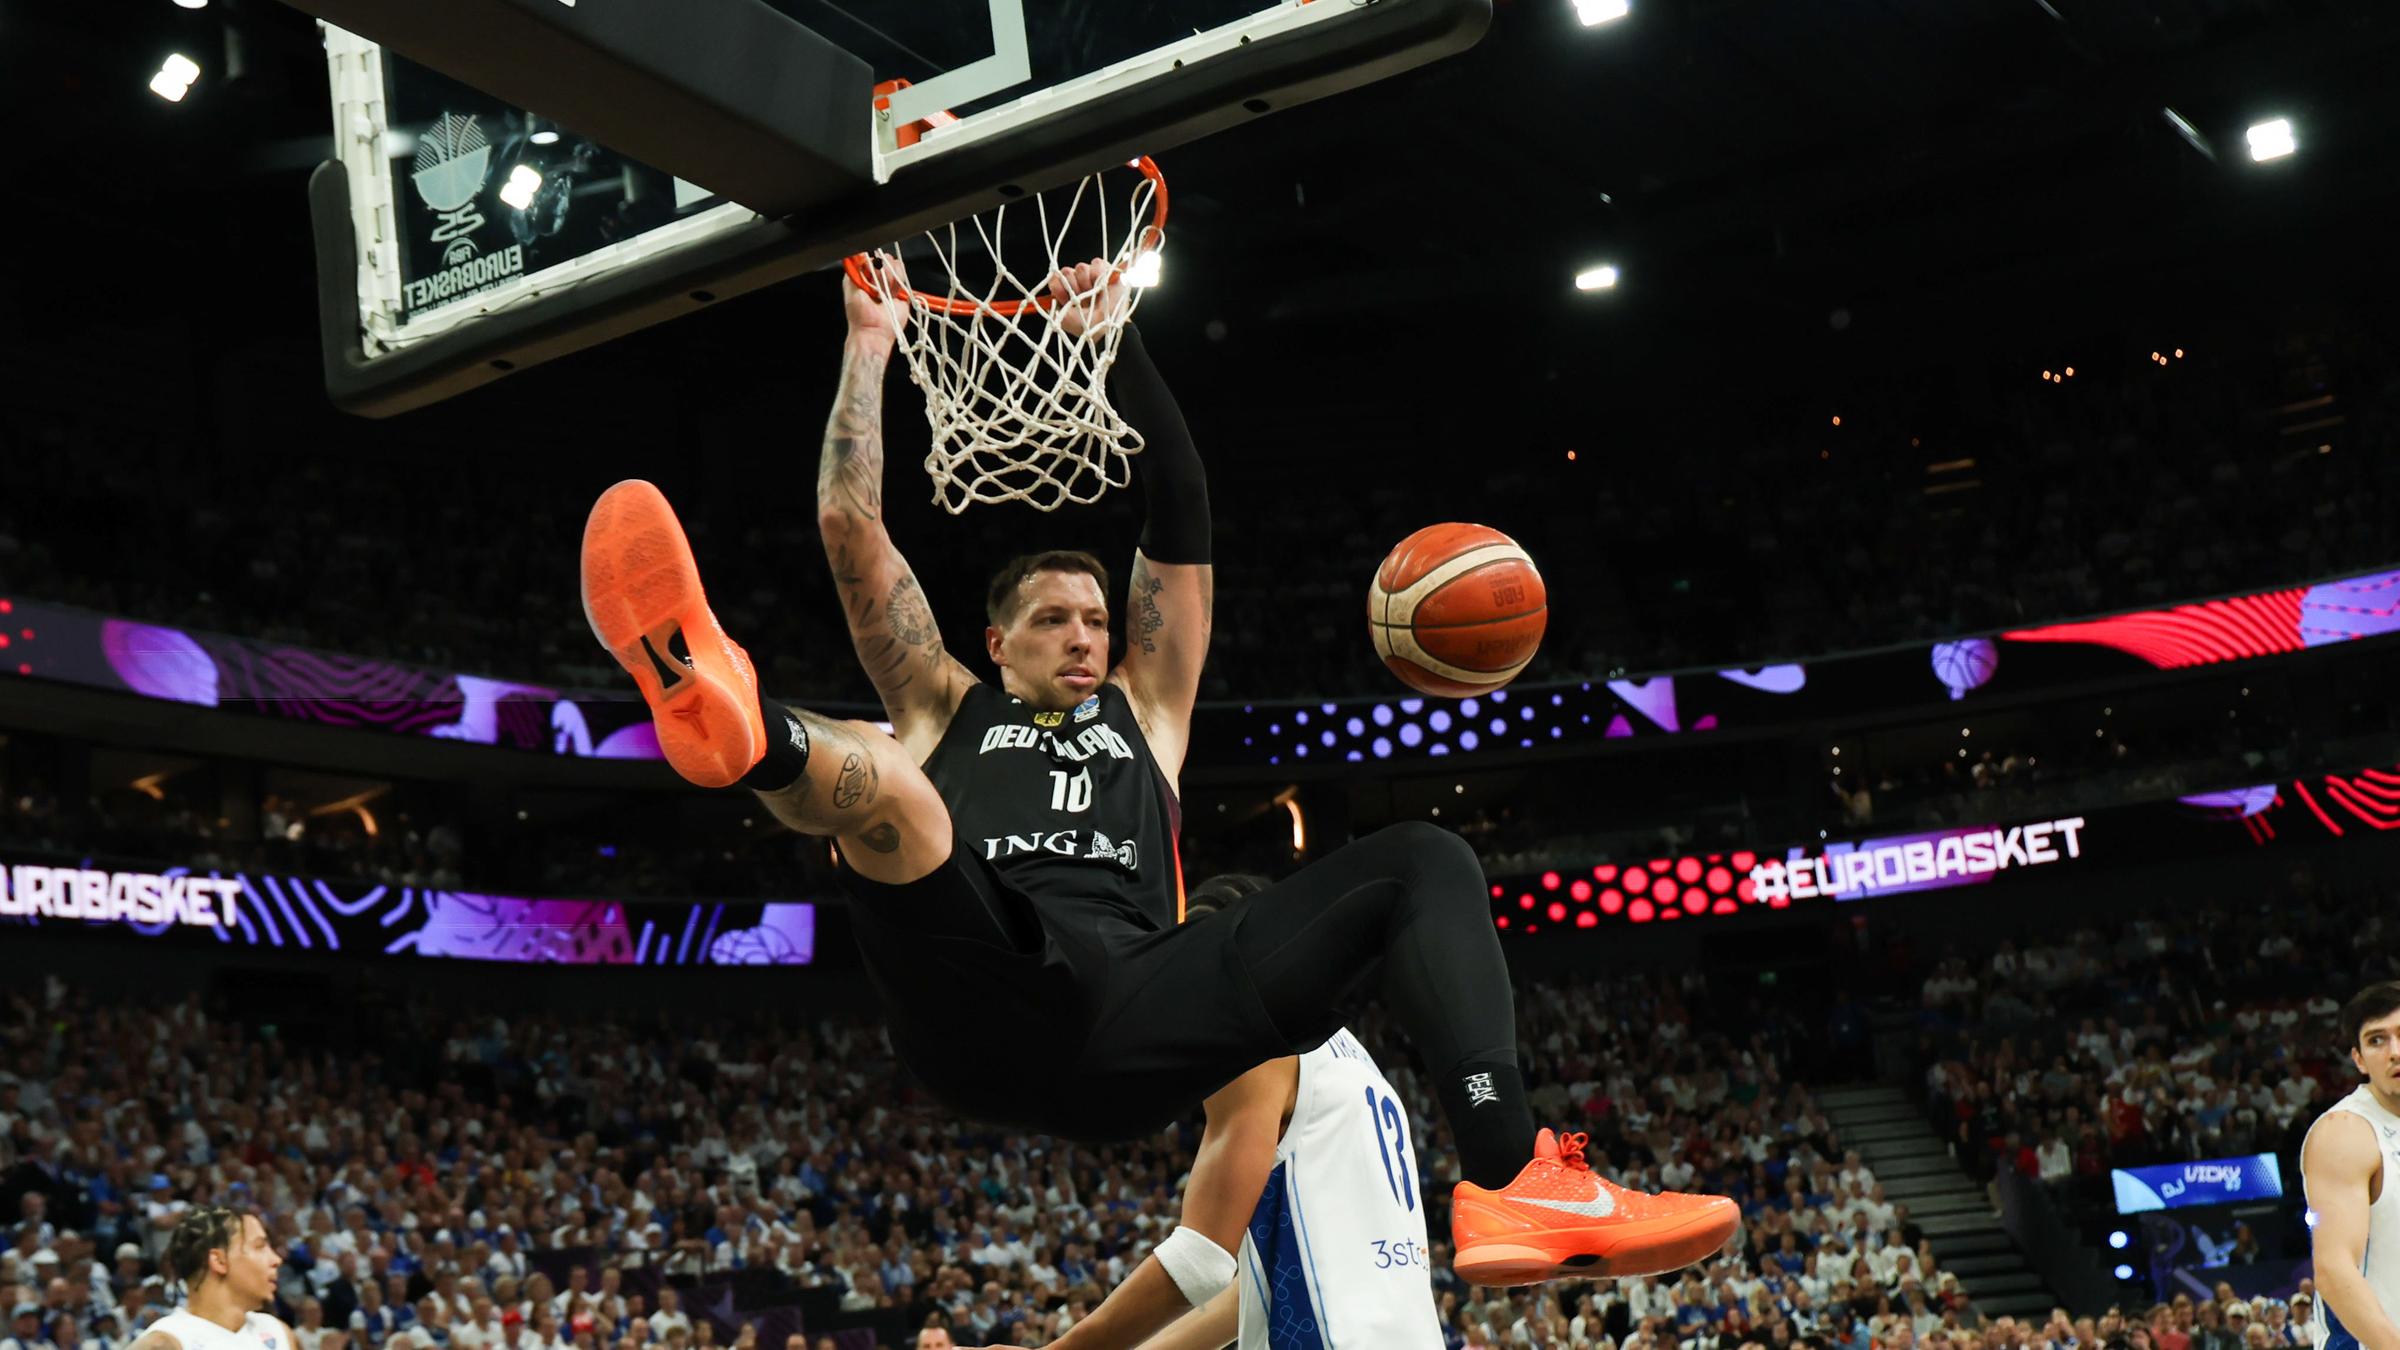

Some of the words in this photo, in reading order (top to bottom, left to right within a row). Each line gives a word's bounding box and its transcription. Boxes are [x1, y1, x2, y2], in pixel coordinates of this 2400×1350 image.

[1493, 586, 1525, 608] FIBA
[1049, 765, 1093, 813] 10
[983, 829, 1078, 860] ING
[1750, 808, 2085, 902] #EUROBASKET
[1463, 1071, 1500, 1108] PEAK
[2160, 1178, 2186, 1199] DJ
[2184, 1165, 2242, 1184] VICKY
